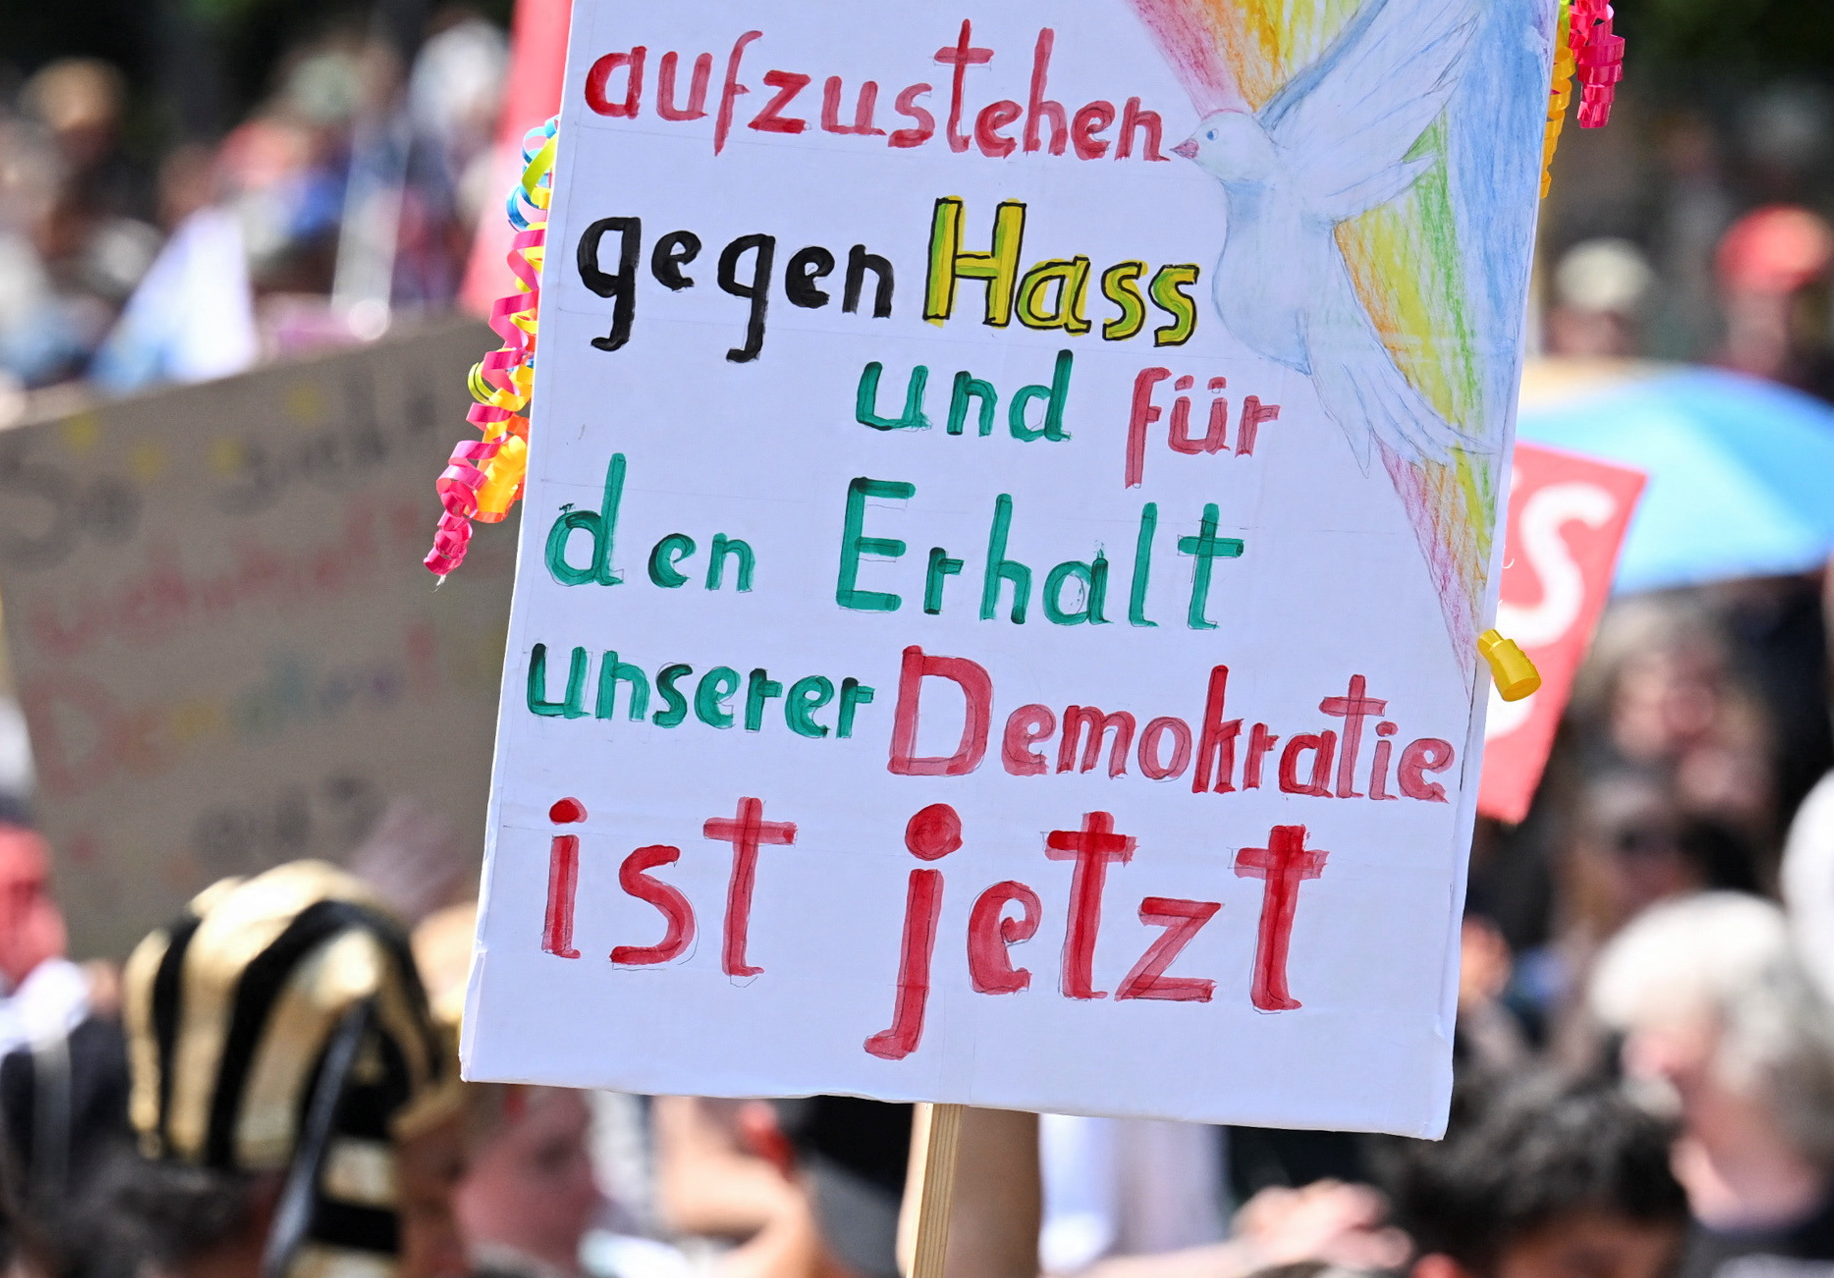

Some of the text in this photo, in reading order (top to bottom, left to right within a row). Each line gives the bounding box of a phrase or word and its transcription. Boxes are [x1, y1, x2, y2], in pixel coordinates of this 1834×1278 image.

[583, 18, 1170, 163] aufzustehen
[577, 195, 1201, 363] gegen Hass
[855, 349, 1280, 489] und für
[543, 452, 1245, 631] den Erhalt
[525, 642, 1456, 804] unserer Demokratie
[541, 796, 1330, 1061] ist jetzt
